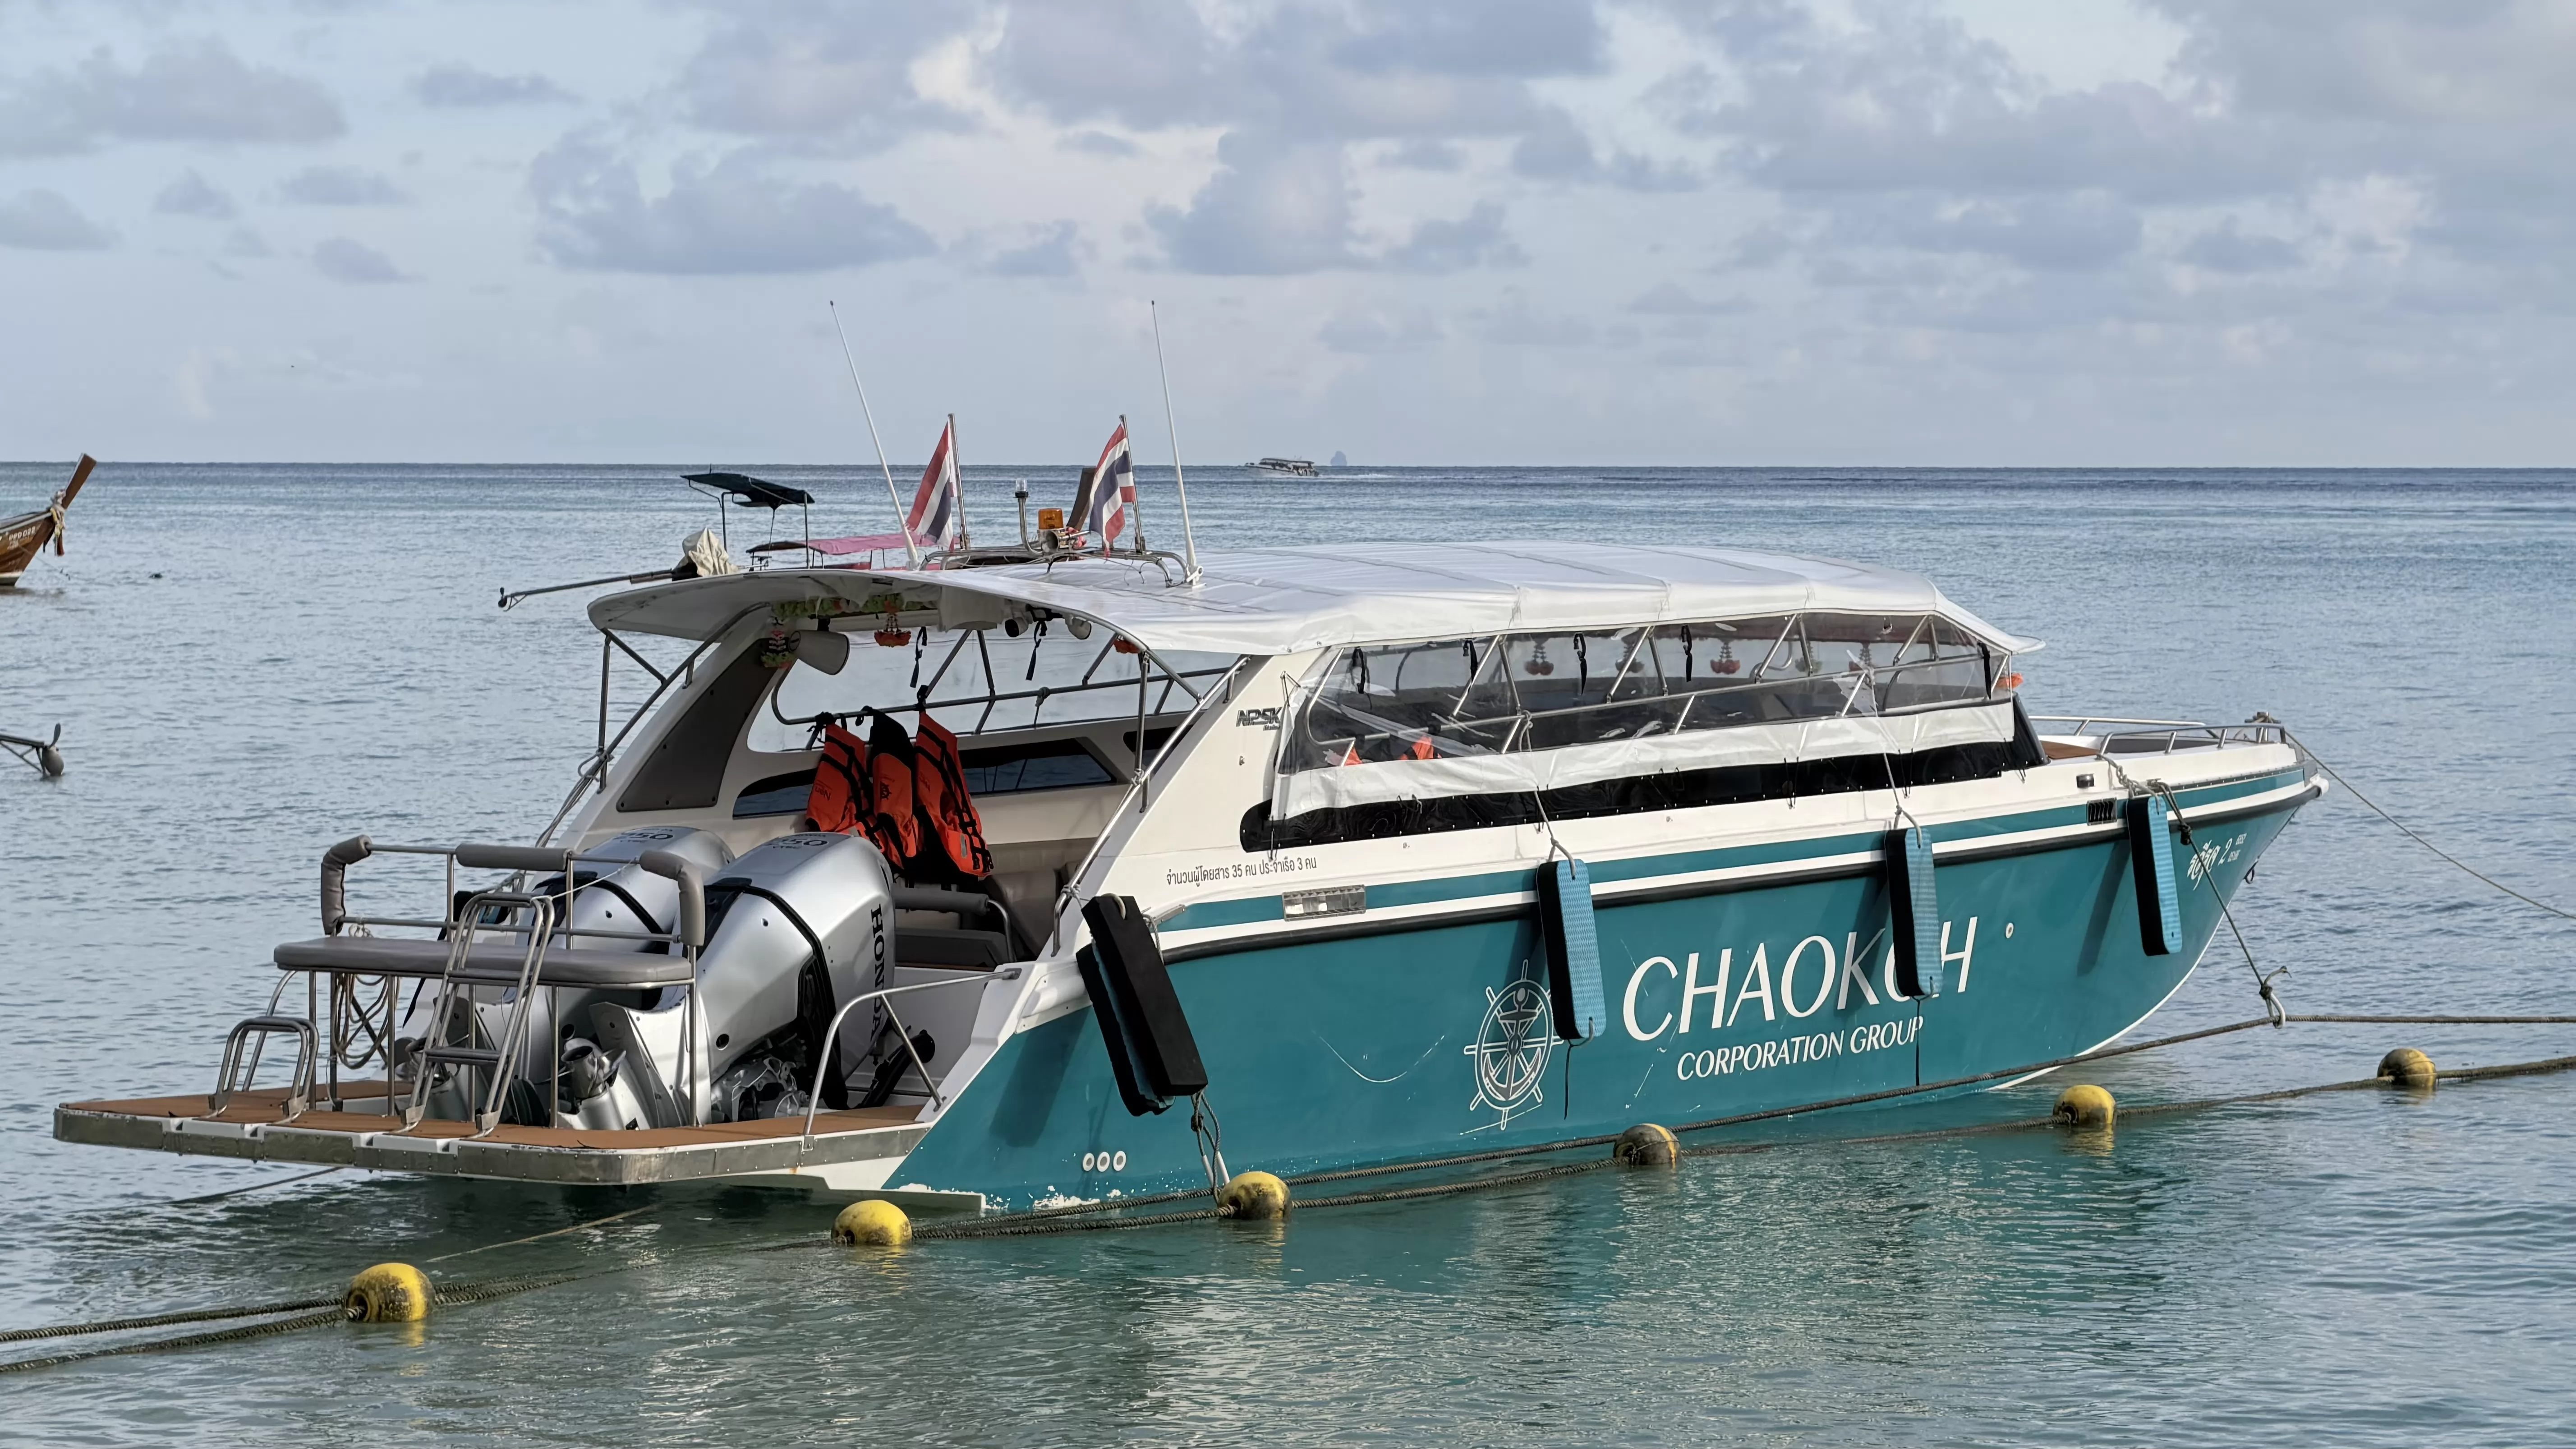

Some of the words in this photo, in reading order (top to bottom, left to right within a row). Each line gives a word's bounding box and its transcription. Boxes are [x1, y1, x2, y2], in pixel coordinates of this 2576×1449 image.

[1167, 865, 1230, 887] จำนวนผู้โดยสาร
[1232, 864, 1242, 878] 35
[1245, 864, 1256, 876] คน
[1297, 857, 1303, 870] 3
[1305, 857, 1317, 869] คน
[1677, 1030, 1845, 1080] CORPORATION
[1850, 1016, 1923, 1053] GROUP
